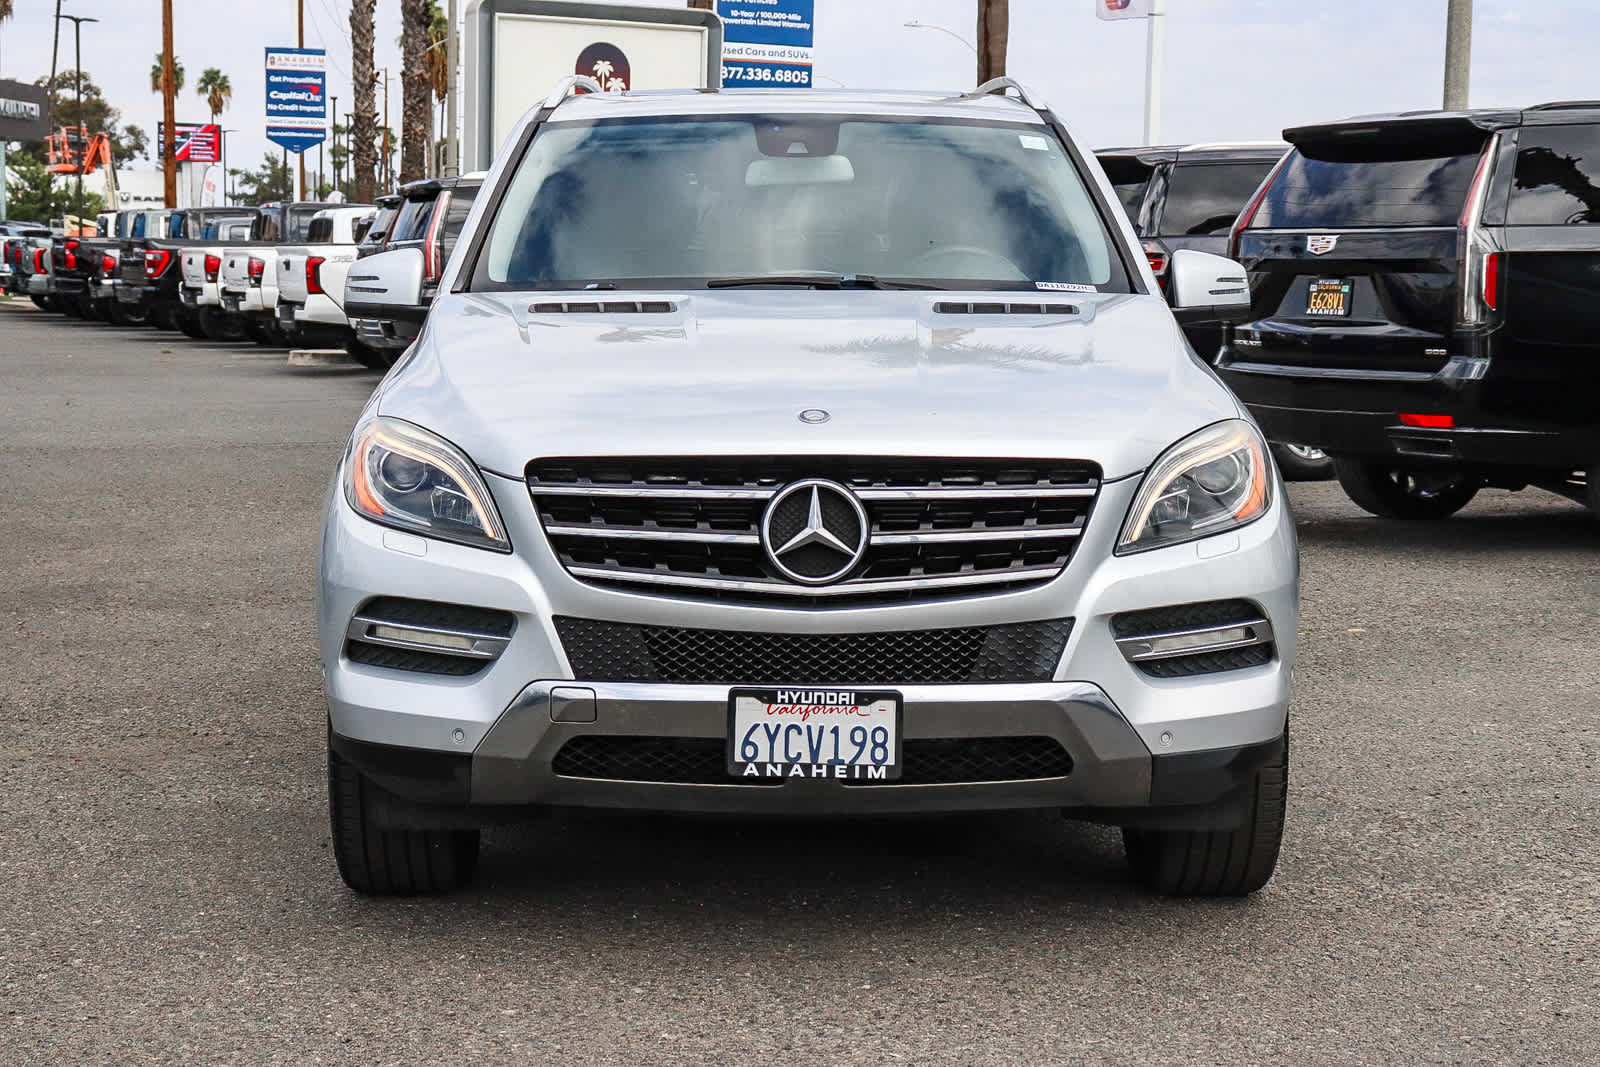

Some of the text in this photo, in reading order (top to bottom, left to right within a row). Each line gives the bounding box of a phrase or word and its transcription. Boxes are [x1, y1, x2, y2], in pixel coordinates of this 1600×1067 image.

[745, 47, 766, 56] Cars
[721, 66, 809, 84] 877.336.6805
[278, 103, 298, 111] Credit
[1310, 292, 1344, 310] E628V1
[777, 690, 856, 705] HYUNDAI
[766, 703, 871, 722] California
[740, 723, 889, 765] 6YCV198
[743, 763, 886, 779] ANAHEIM
